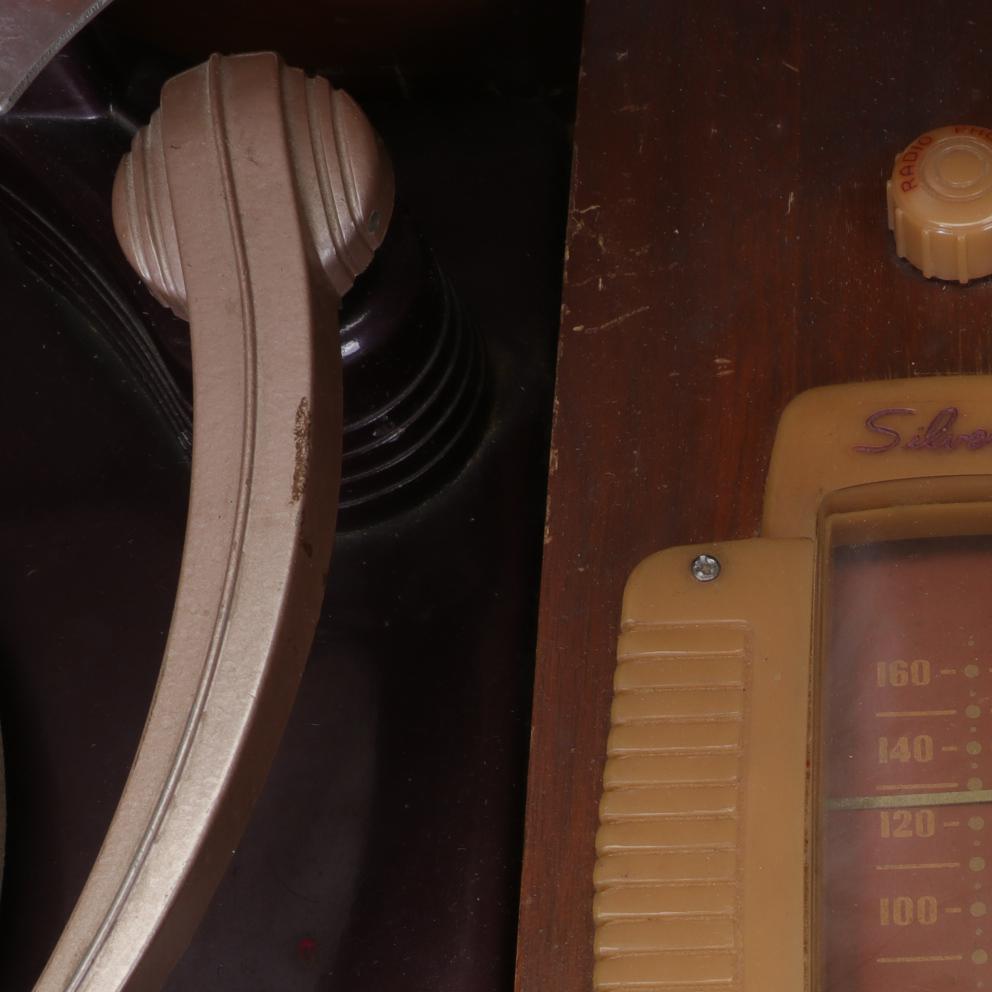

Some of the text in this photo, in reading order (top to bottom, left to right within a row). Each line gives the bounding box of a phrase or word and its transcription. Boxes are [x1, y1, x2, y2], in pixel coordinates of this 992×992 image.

[900, 135, 932, 193] RADIO
[876, 659, 931, 687] 160
[878, 734, 934, 764] 140
[880, 809, 936, 838] 120
[879, 896, 938, 926] 100
